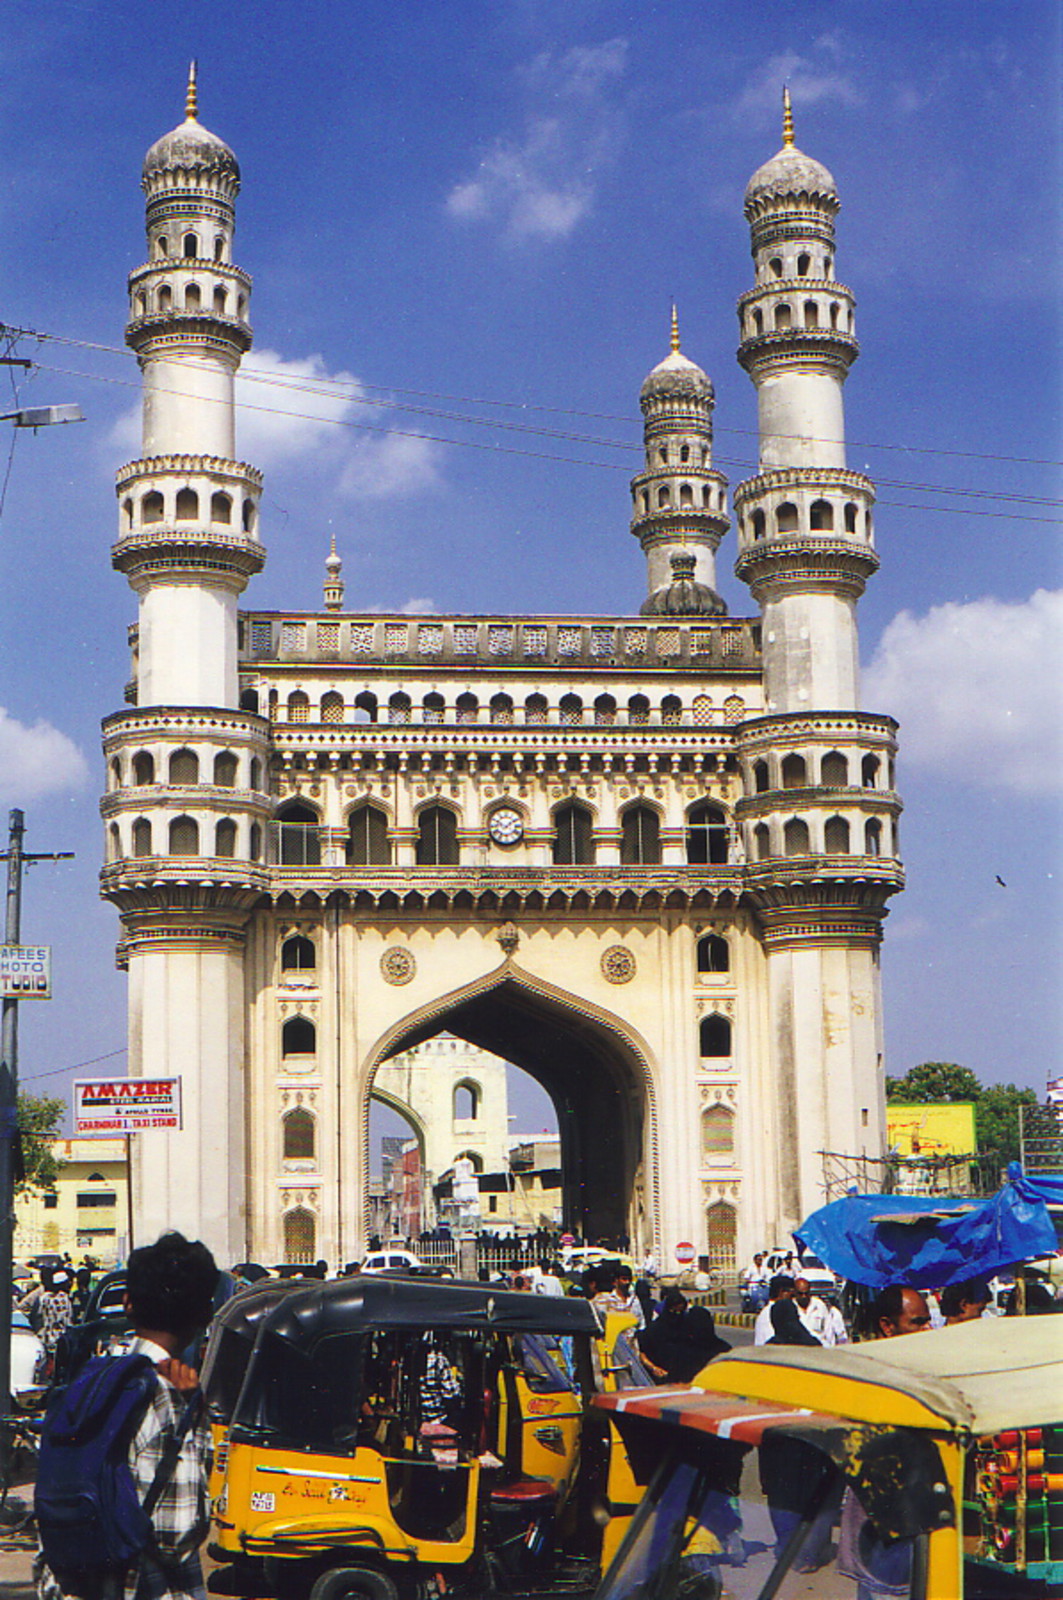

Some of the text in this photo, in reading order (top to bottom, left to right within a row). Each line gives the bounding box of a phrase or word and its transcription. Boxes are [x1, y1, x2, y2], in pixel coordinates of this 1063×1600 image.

[2, 962, 44, 972] HOTO
[1, 975, 47, 991] TUDIO
[81, 1083, 172, 1098] AMAZER
